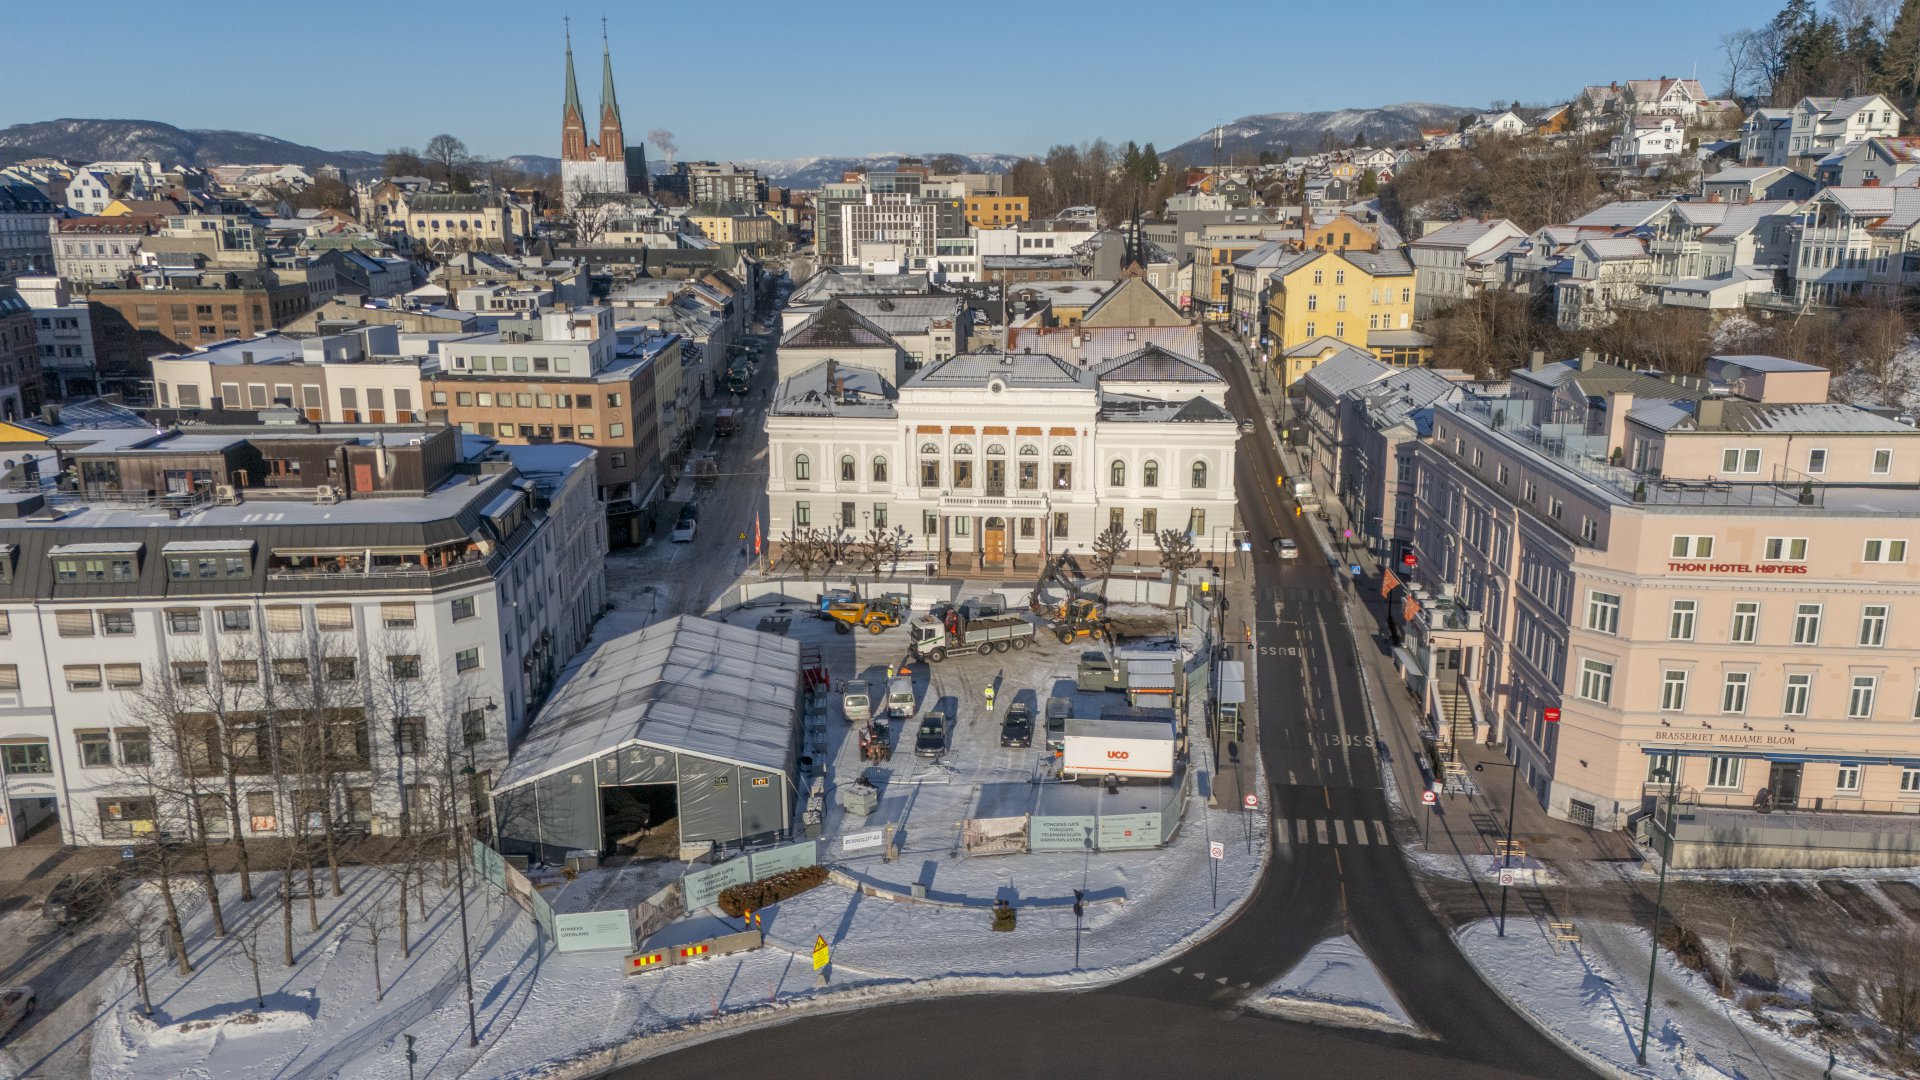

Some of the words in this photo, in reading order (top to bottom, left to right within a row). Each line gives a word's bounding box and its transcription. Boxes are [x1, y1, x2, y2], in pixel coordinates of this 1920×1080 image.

[1668, 562, 1706, 572] THON
[1709, 563, 1752, 573] HOTEL
[1755, 565, 1807, 574] HØYERS
[1260, 646, 1296, 656] BUSS
[1331, 734, 1375, 748] BUSS
[1655, 731, 1714, 742] BRASSERIET
[1719, 733, 1763, 744] MADAME
[1766, 736, 1795, 745] BLOM
[1107, 750, 1129, 759] UCO
